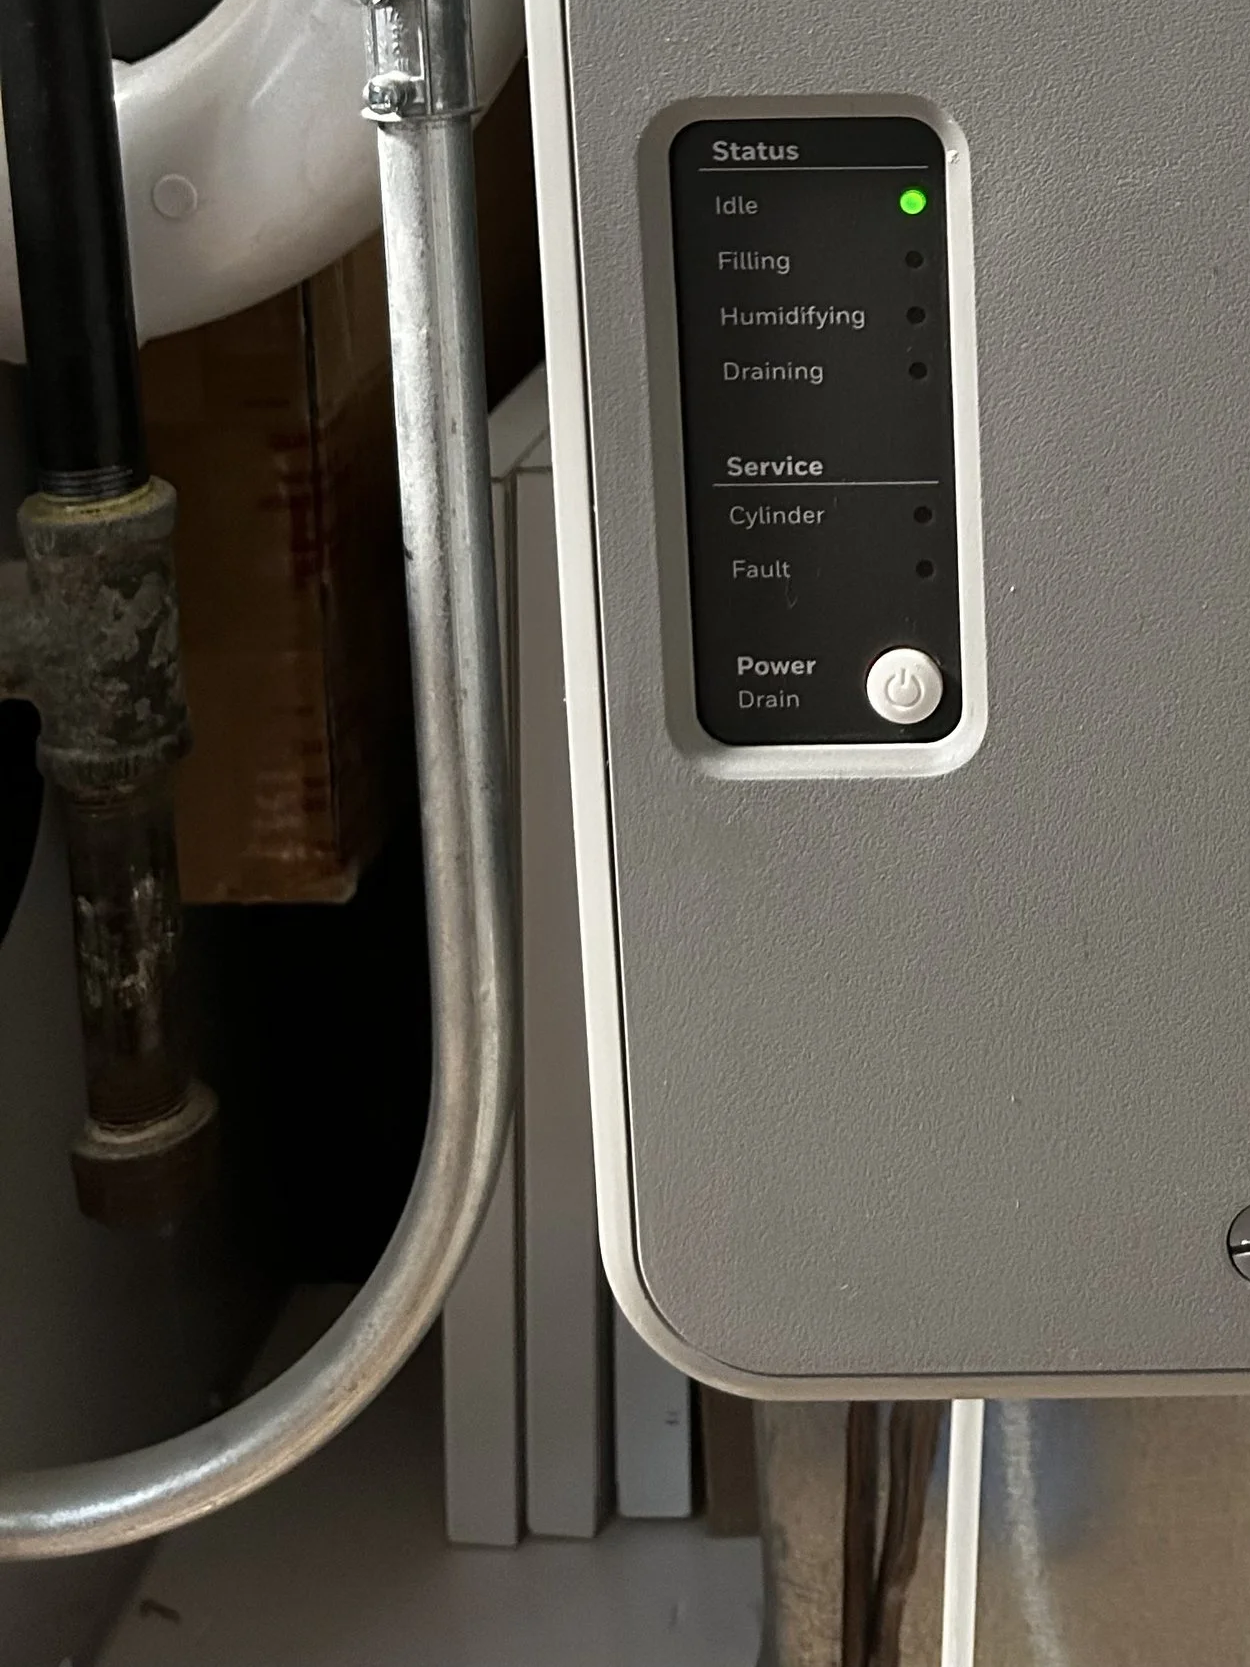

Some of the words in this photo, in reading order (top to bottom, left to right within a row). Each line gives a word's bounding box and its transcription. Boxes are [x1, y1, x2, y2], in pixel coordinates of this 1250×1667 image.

[711, 140, 800, 162] Status
[715, 195, 758, 215] Idle
[718, 251, 790, 275] Filling
[720, 306, 866, 329] Humidifying
[723, 361, 824, 385] Draining
[726, 455, 825, 477] Service
[729, 505, 825, 530] Cylinder
[732, 559, 791, 579] Fault
[736, 656, 817, 676] Power
[738, 690, 801, 709] Drain
